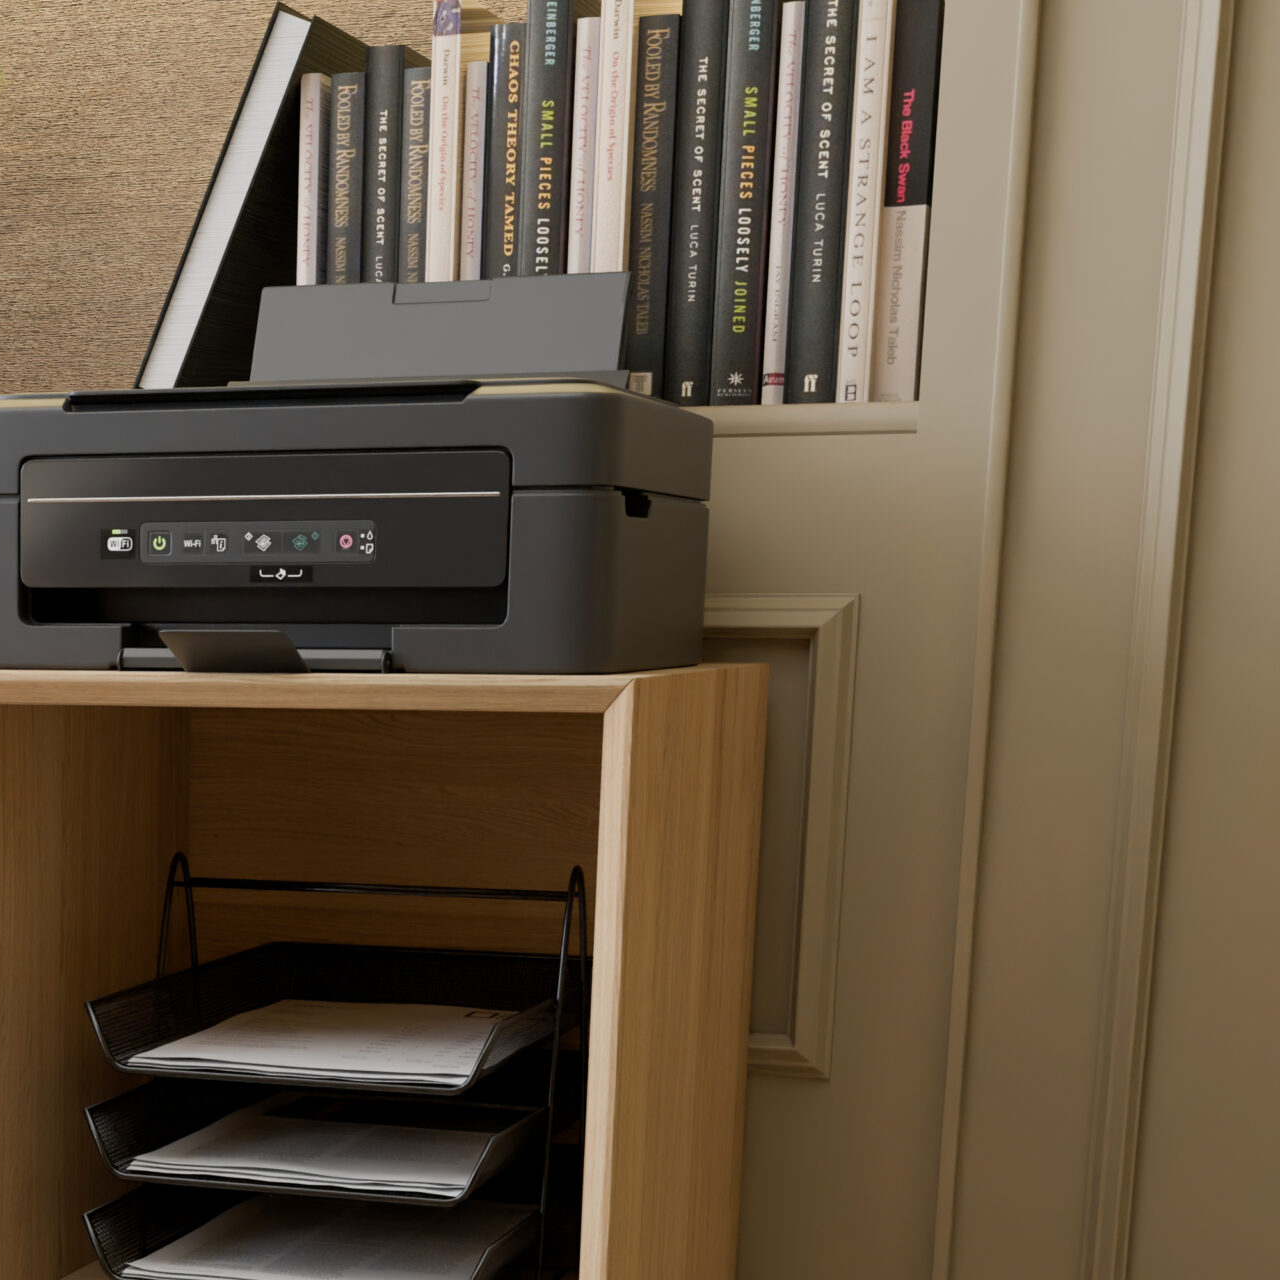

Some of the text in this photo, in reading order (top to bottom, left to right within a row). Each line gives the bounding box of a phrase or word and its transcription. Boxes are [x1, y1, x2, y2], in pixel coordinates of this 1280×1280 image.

[443, 49, 451, 86] Darwin
[611, 70, 620, 88] the
[612, 51, 620, 68] On
[817, 0, 838, 179] THE SECRET OF SCENT
[440, 113, 449, 128] the
[441, 96, 449, 111] On
[608, 90, 618, 127] Origin
[640, 27, 670, 193] FOOLED BY RANDOMNESS
[691, 56, 709, 212] THE SECRET OF SCENT
[861, 110, 872, 124] A
[335, 84, 358, 228] FOOLED BY RANDOMNESS
[376, 109, 388, 245] THE SECRET OF SCENT
[407, 79, 430, 224] FOOLED BY RANDOMNESS
[439, 129, 448, 163] Origin
[503, 40, 520, 257] CHAOS THEORY TAMED
[606, 142, 616, 181] Species
[896, 88, 915, 203] The Black Swan
[438, 177, 446, 211] Species
[535, 100, 555, 275] SMALL PIECES LOOSEL
[732, 86, 758, 333] SMALL PIECES LOOSELY JOINED
[852, 138, 871, 268] STRANGE
[335, 237, 347, 272] NASSIM
[407, 233, 419, 269] NASSIM
[502, 263, 511, 276] G.
[636, 202, 654, 335] NASSIM NICHOLAS TALEB
[687, 224, 699, 302] LUCA TURIN
[811, 193, 826, 283] LUCA TURIN
[847, 282, 862, 357] LOOP
[886, 210, 907, 366] Nassim Nicholas Taleb
[183, 539, 201, 548] Wi-Fi
